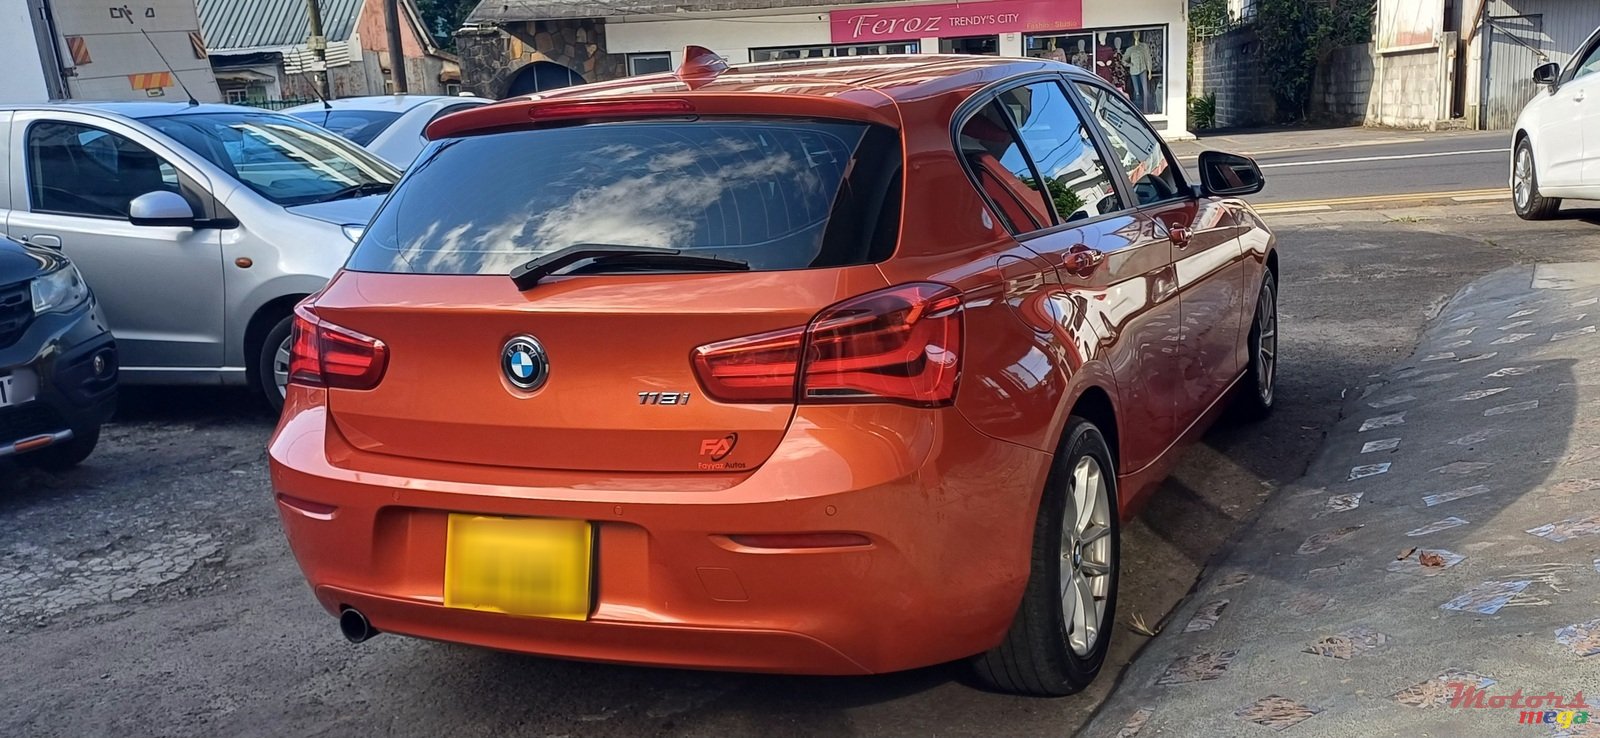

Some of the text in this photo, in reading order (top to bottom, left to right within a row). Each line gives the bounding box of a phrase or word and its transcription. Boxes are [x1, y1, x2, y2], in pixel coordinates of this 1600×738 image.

[848, 13, 1019, 38] Feroz TRENDY'S CITY
[507, 344, 537, 358] BMW
[700, 439, 732, 455] FA
[698, 462, 724, 470] Fayyaz
